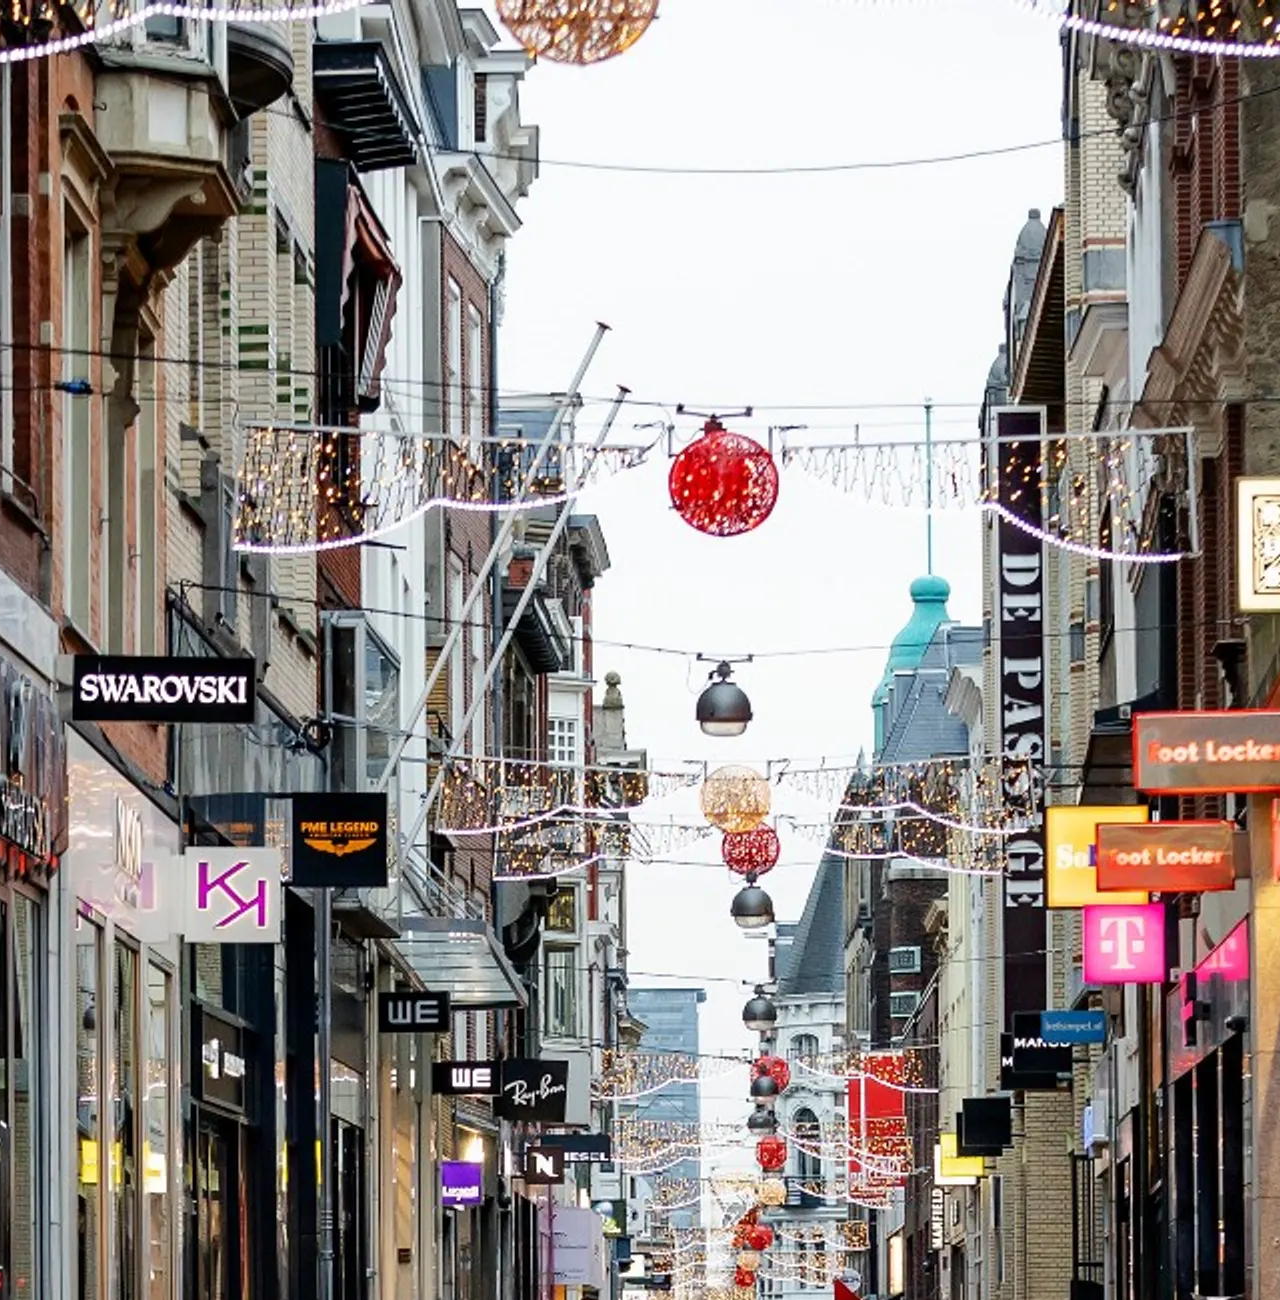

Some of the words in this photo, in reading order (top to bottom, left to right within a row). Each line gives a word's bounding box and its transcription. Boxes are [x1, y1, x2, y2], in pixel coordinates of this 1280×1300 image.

[1001, 552, 1041, 622] DE
[79, 673, 248, 704] SWAROVSKI
[1148, 739, 1199, 763] Foot
[301, 821, 328, 833] PME
[330, 821, 379, 833] LEGEND
[1156, 846, 1225, 865] Locker
[1099, 917, 1146, 970] T
[387, 1000, 439, 1024] WE
[451, 1067, 492, 1088] WE
[563, 1151, 610, 1162] IESEL
[931, 1188, 944, 1250] MANFIELD
